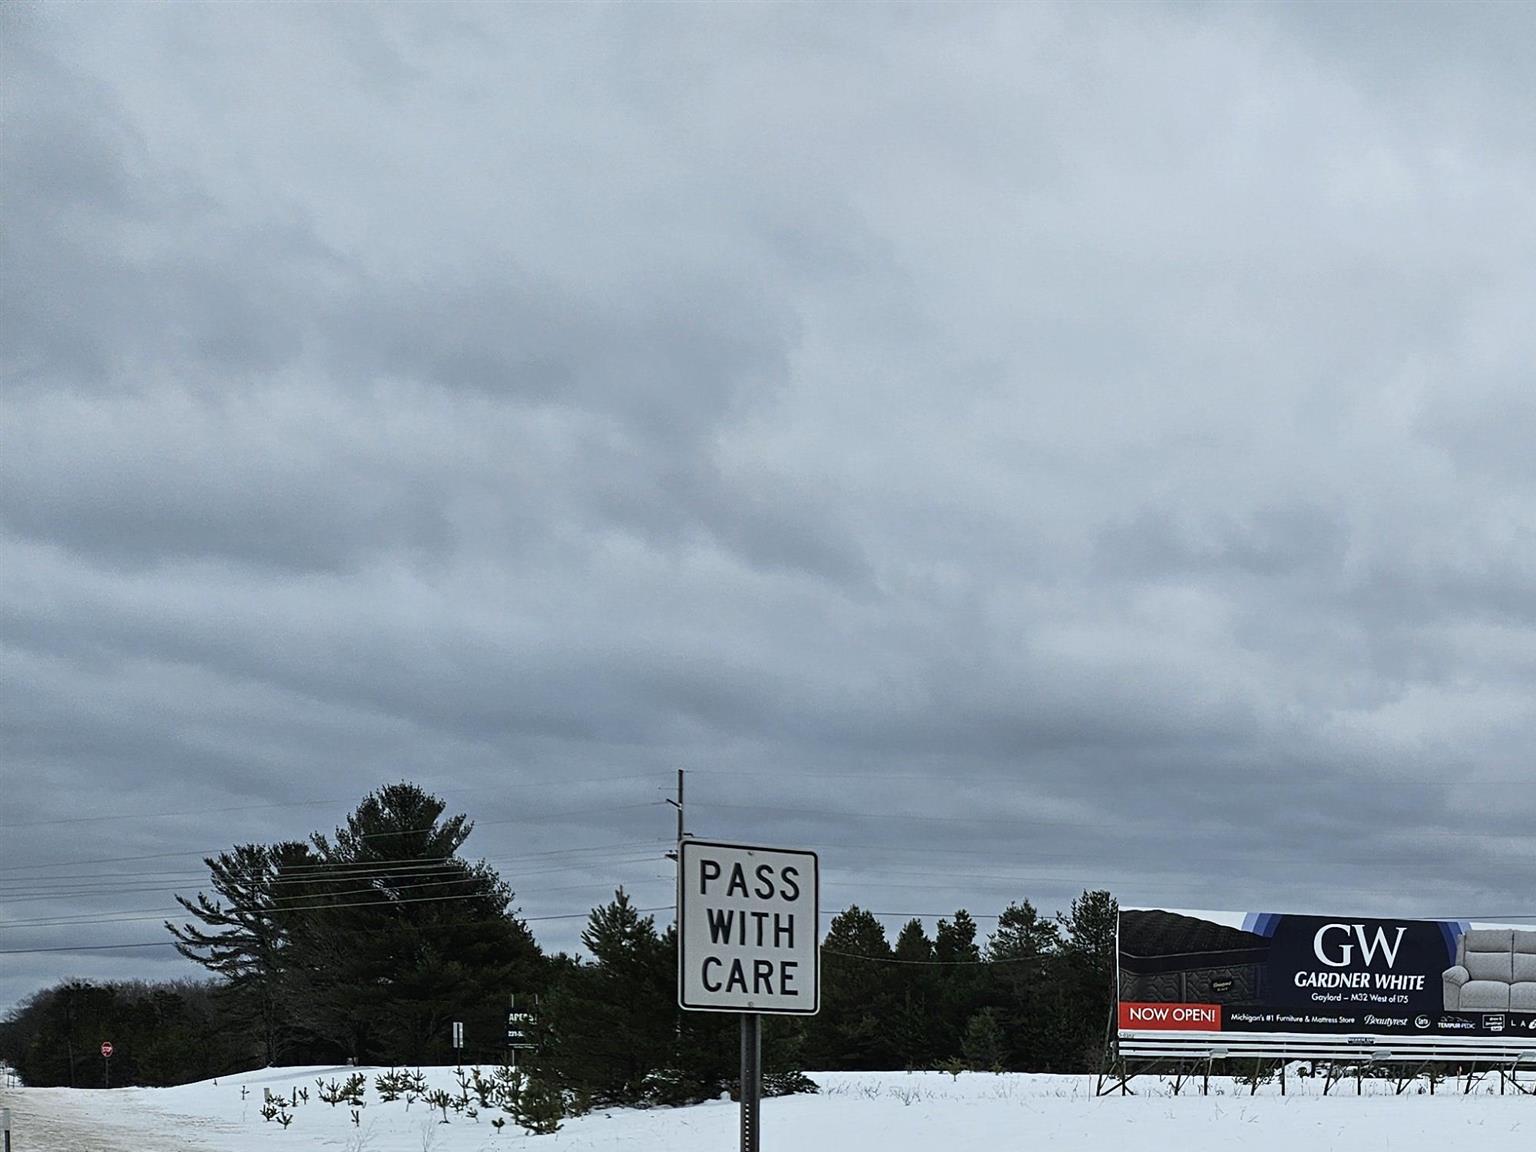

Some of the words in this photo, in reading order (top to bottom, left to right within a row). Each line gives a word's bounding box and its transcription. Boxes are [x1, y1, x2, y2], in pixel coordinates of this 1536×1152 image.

[700, 859, 799, 901] PASS
[707, 908, 794, 948] WITH
[1313, 923, 1407, 968] GW
[702, 957, 798, 995] CARE
[1294, 971, 1370, 988] GARDNER
[1375, 974, 1425, 990] WHITE
[1311, 993, 1341, 1003] Gaylord
[1351, 993, 1368, 1001] M32
[1369, 994, 1387, 1002] West
[1388, 994, 1396, 1003] of
[1129, 1008, 1169, 1021] NOW
[1172, 1008, 1216, 1022] OPEN!
[1231, 1014, 1264, 1023] Michigan's
[1276, 1014, 1303, 1022] Furniture
[1364, 1014, 1407, 1027] Beautyrest
